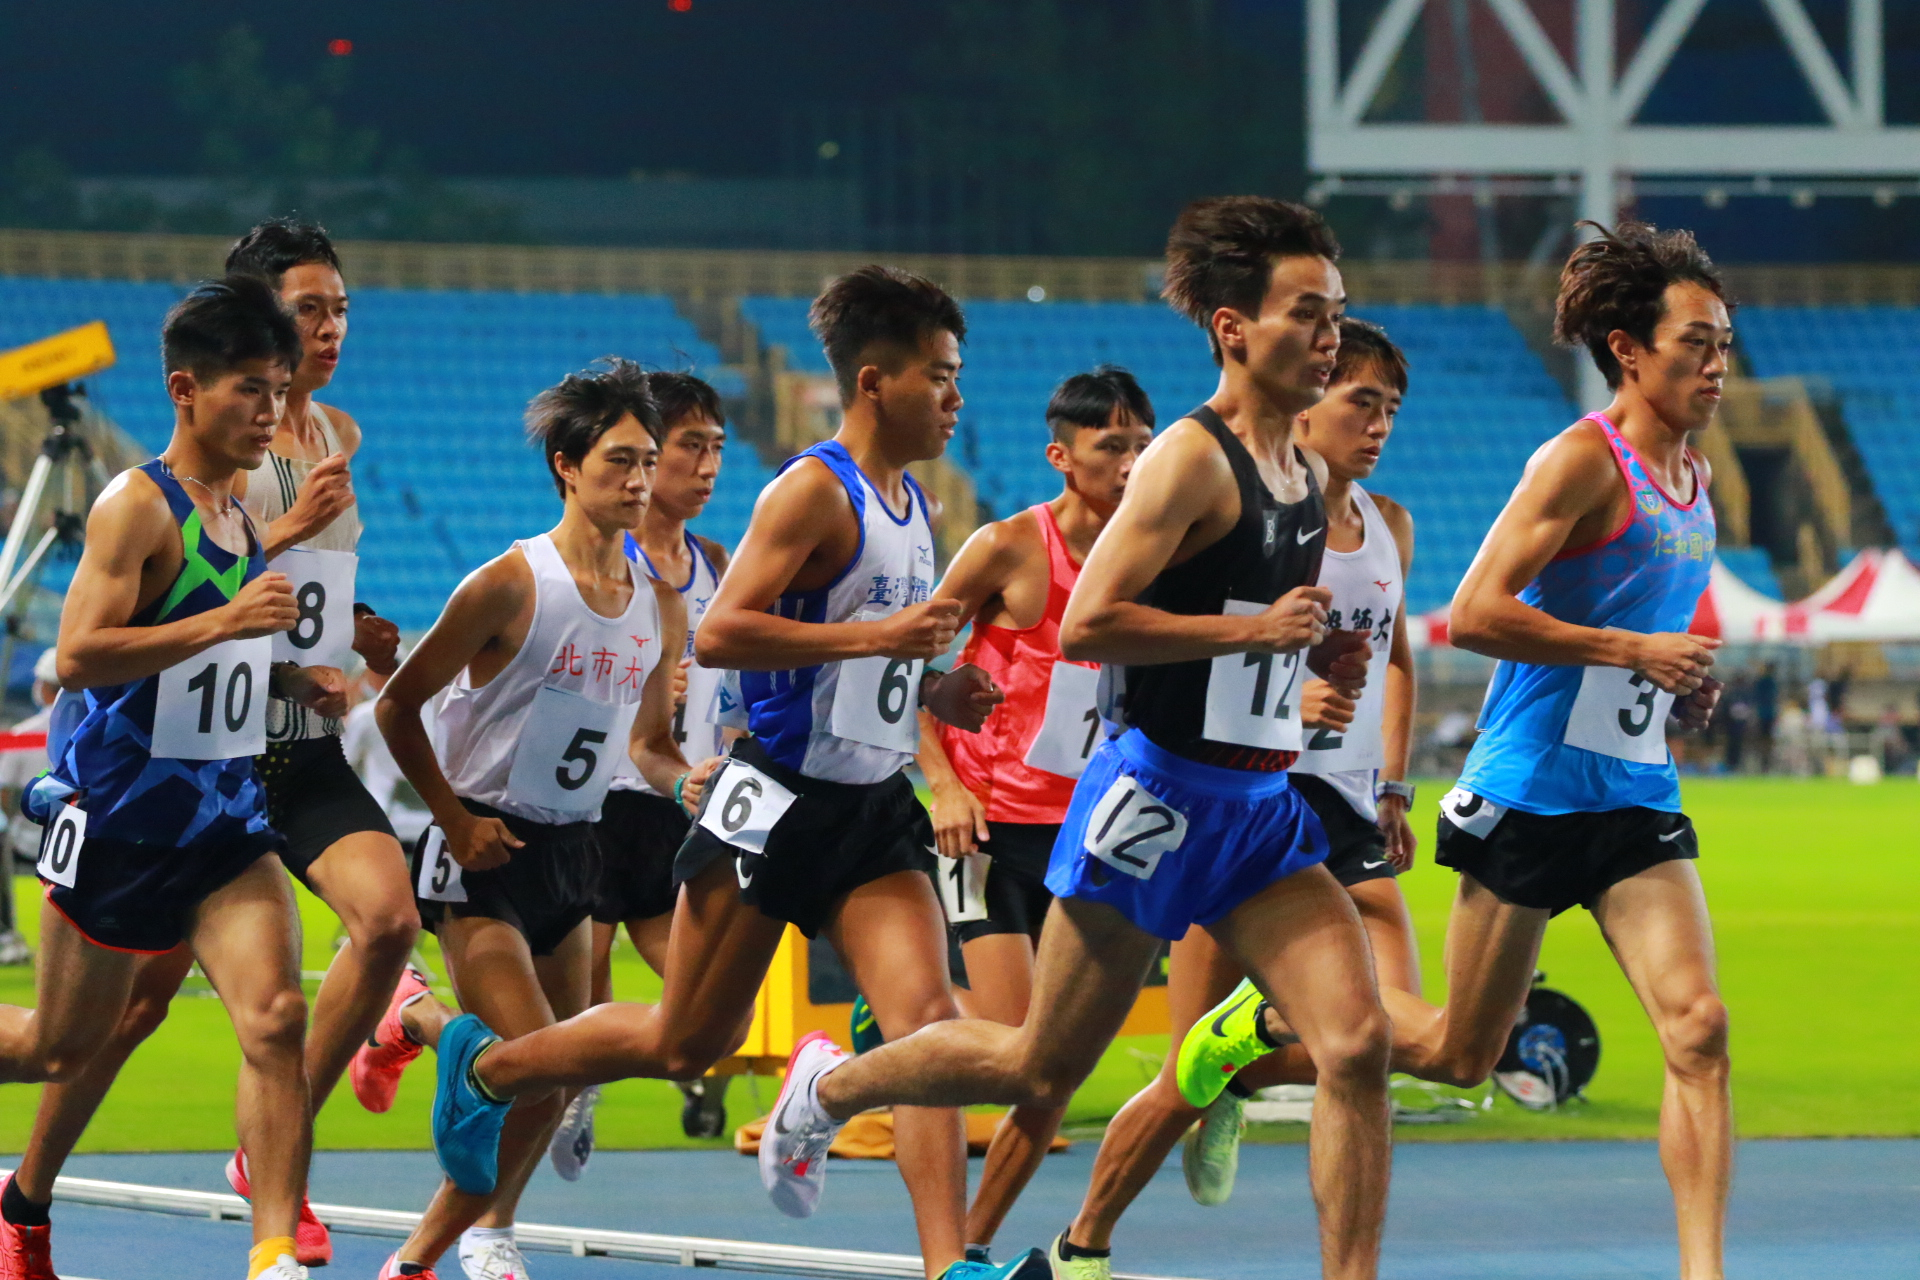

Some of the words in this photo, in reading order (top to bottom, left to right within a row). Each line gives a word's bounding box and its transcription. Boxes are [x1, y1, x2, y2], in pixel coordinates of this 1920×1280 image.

[287, 581, 326, 650] 8
[866, 574, 934, 608] 臺灣體
[187, 661, 253, 734] 10
[877, 657, 913, 725] 6
[1243, 649, 1300, 720] 12
[1617, 672, 1659, 737] 3
[555, 727, 608, 791] 5
[1083, 706, 1101, 759] 1
[721, 776, 763, 833] 6
[1095, 788, 1176, 870] 12
[431, 838, 451, 894] 5
[949, 858, 965, 914] 1
